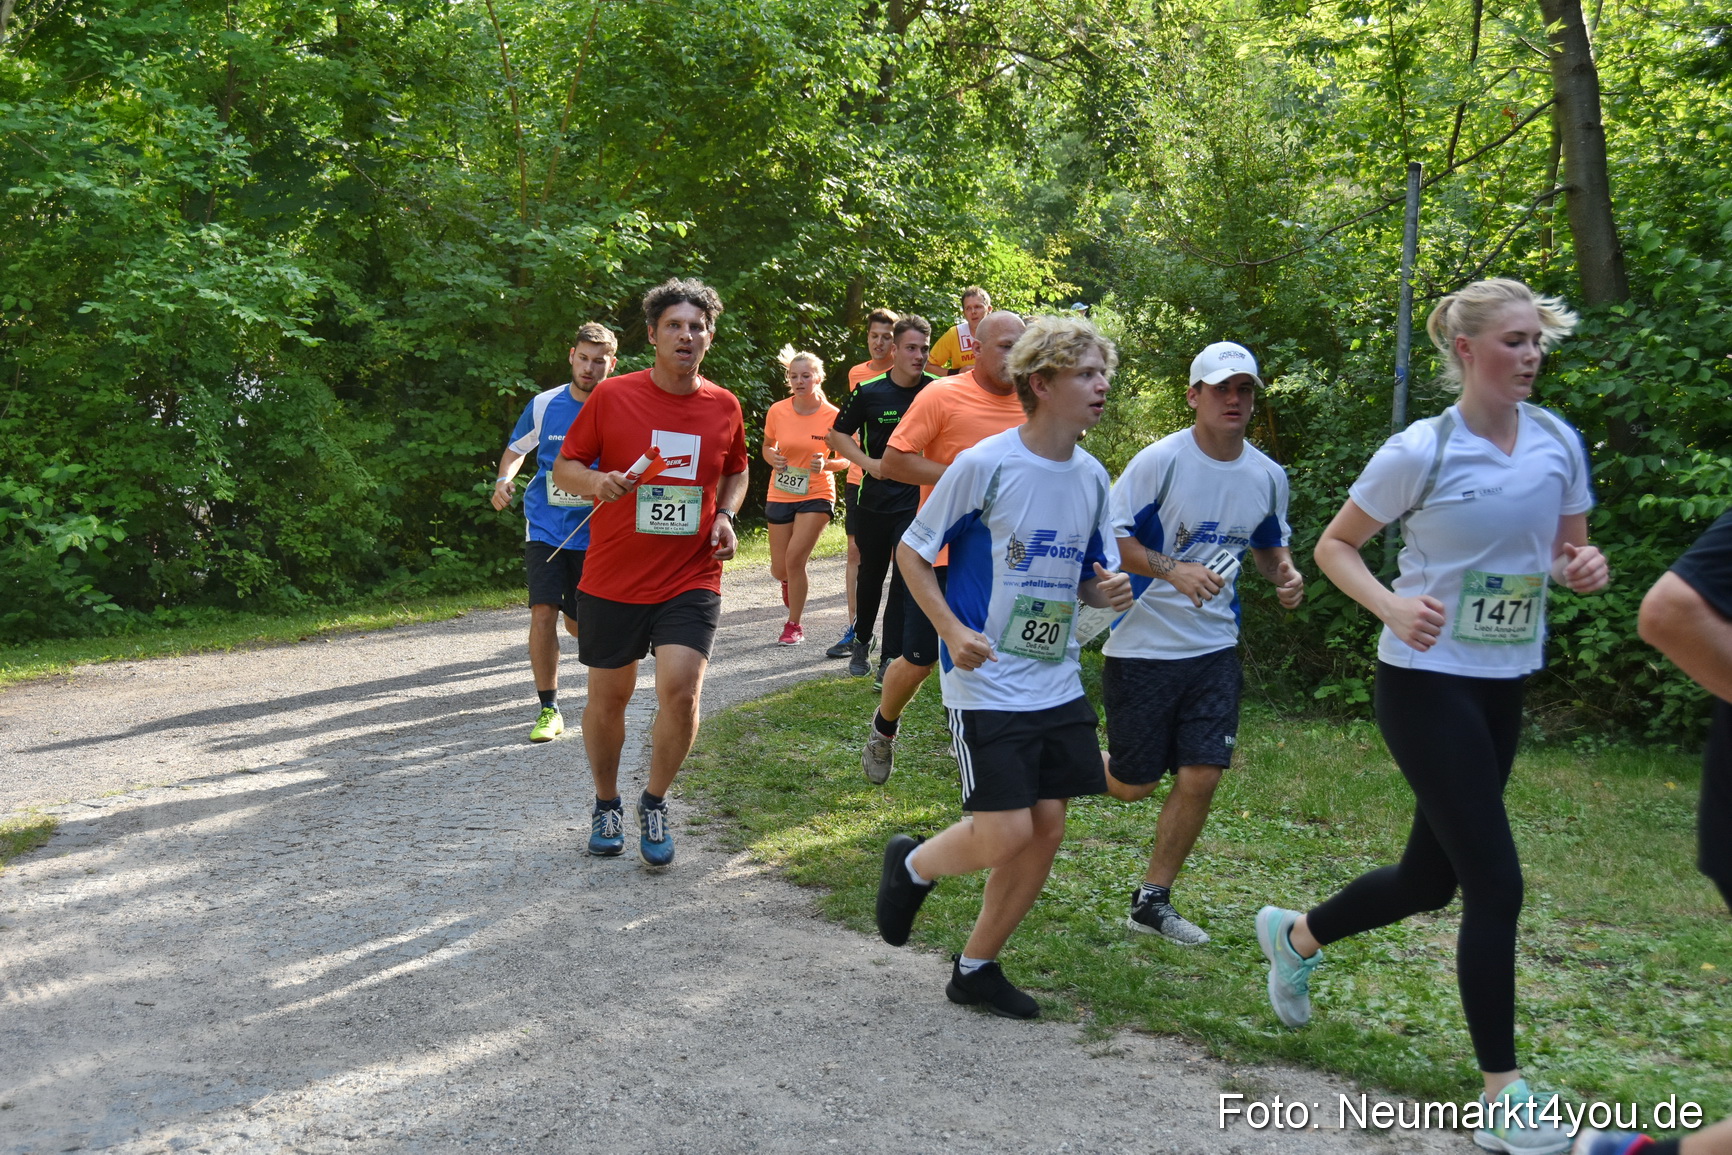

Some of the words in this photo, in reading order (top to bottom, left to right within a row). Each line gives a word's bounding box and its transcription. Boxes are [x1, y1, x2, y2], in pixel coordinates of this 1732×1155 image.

[777, 473, 804, 487] 2287
[651, 503, 686, 521] 521
[1472, 598, 1532, 625] 1471
[1021, 620, 1060, 645] 820
